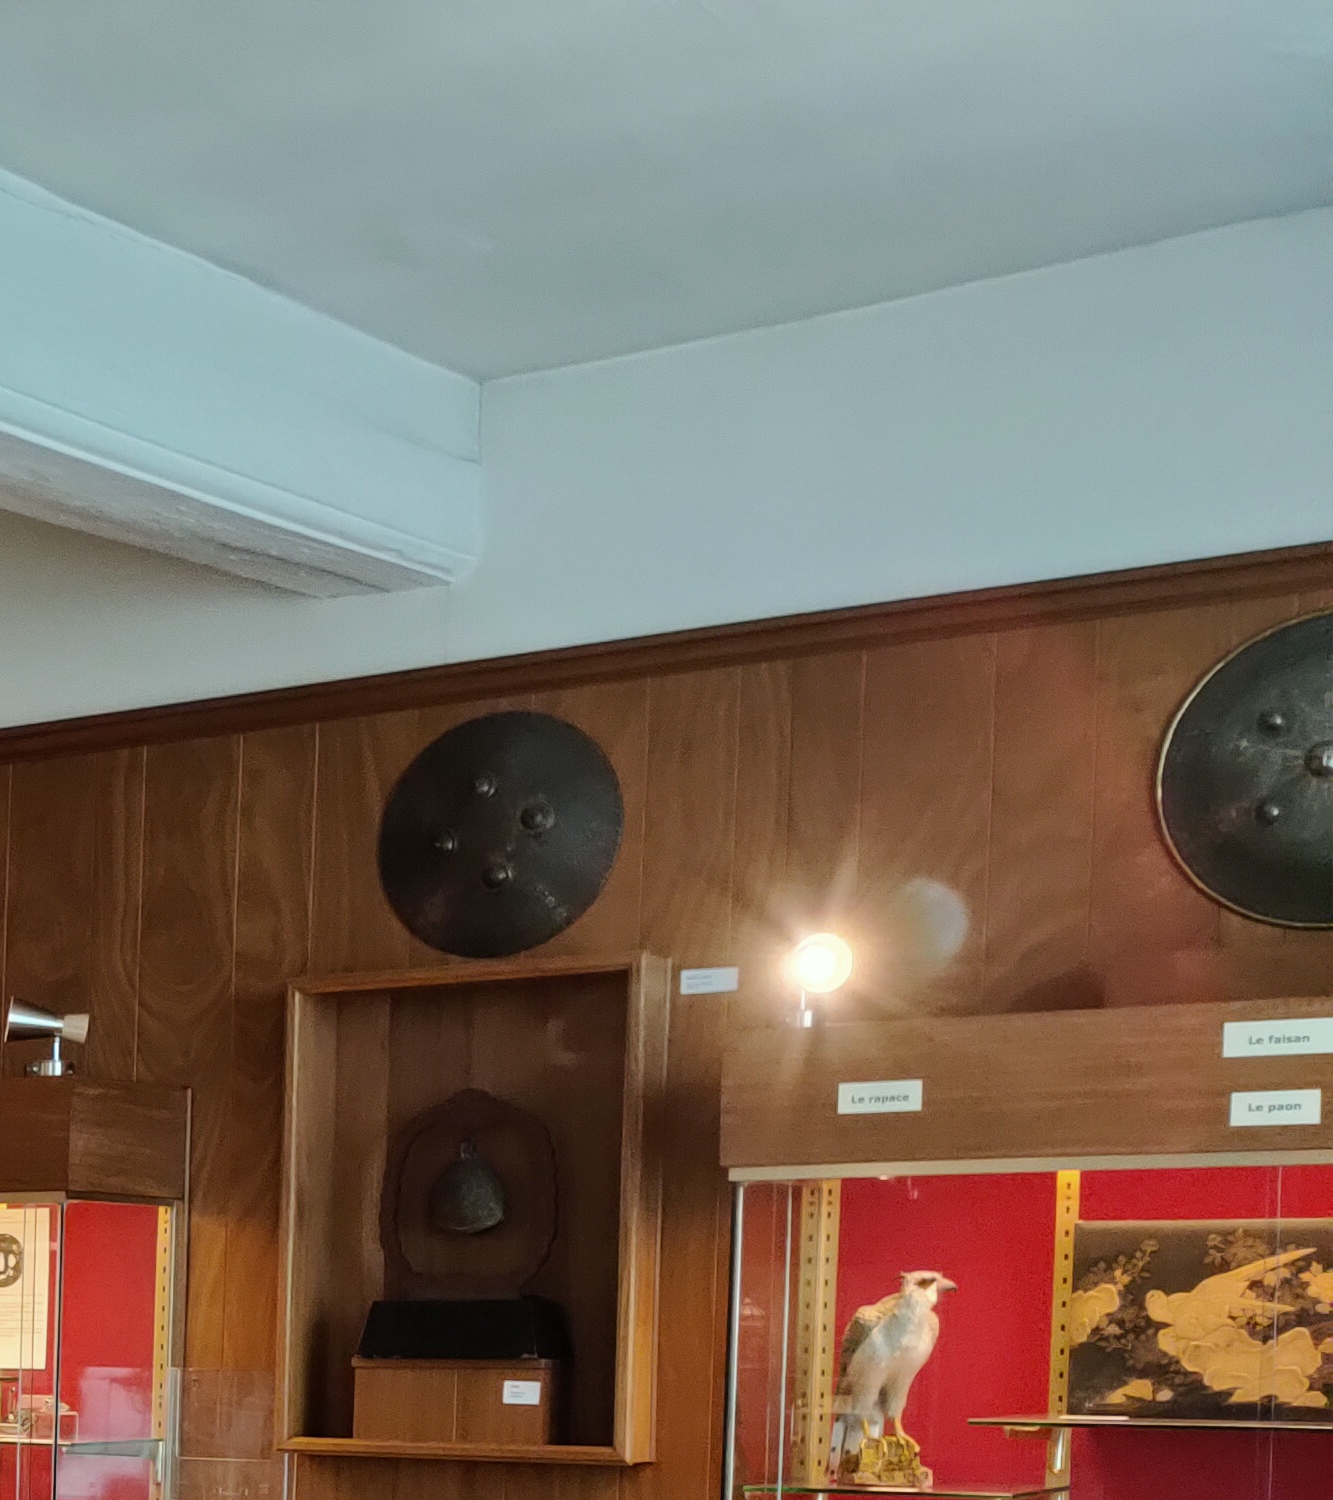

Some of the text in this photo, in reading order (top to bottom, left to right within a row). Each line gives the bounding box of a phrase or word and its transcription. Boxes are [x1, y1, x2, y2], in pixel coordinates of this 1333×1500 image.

[1248, 1034, 1310, 1045] Le faisan
[851, 1094, 910, 1106] Le rapace
[1248, 1102, 1302, 1114] Le paon
